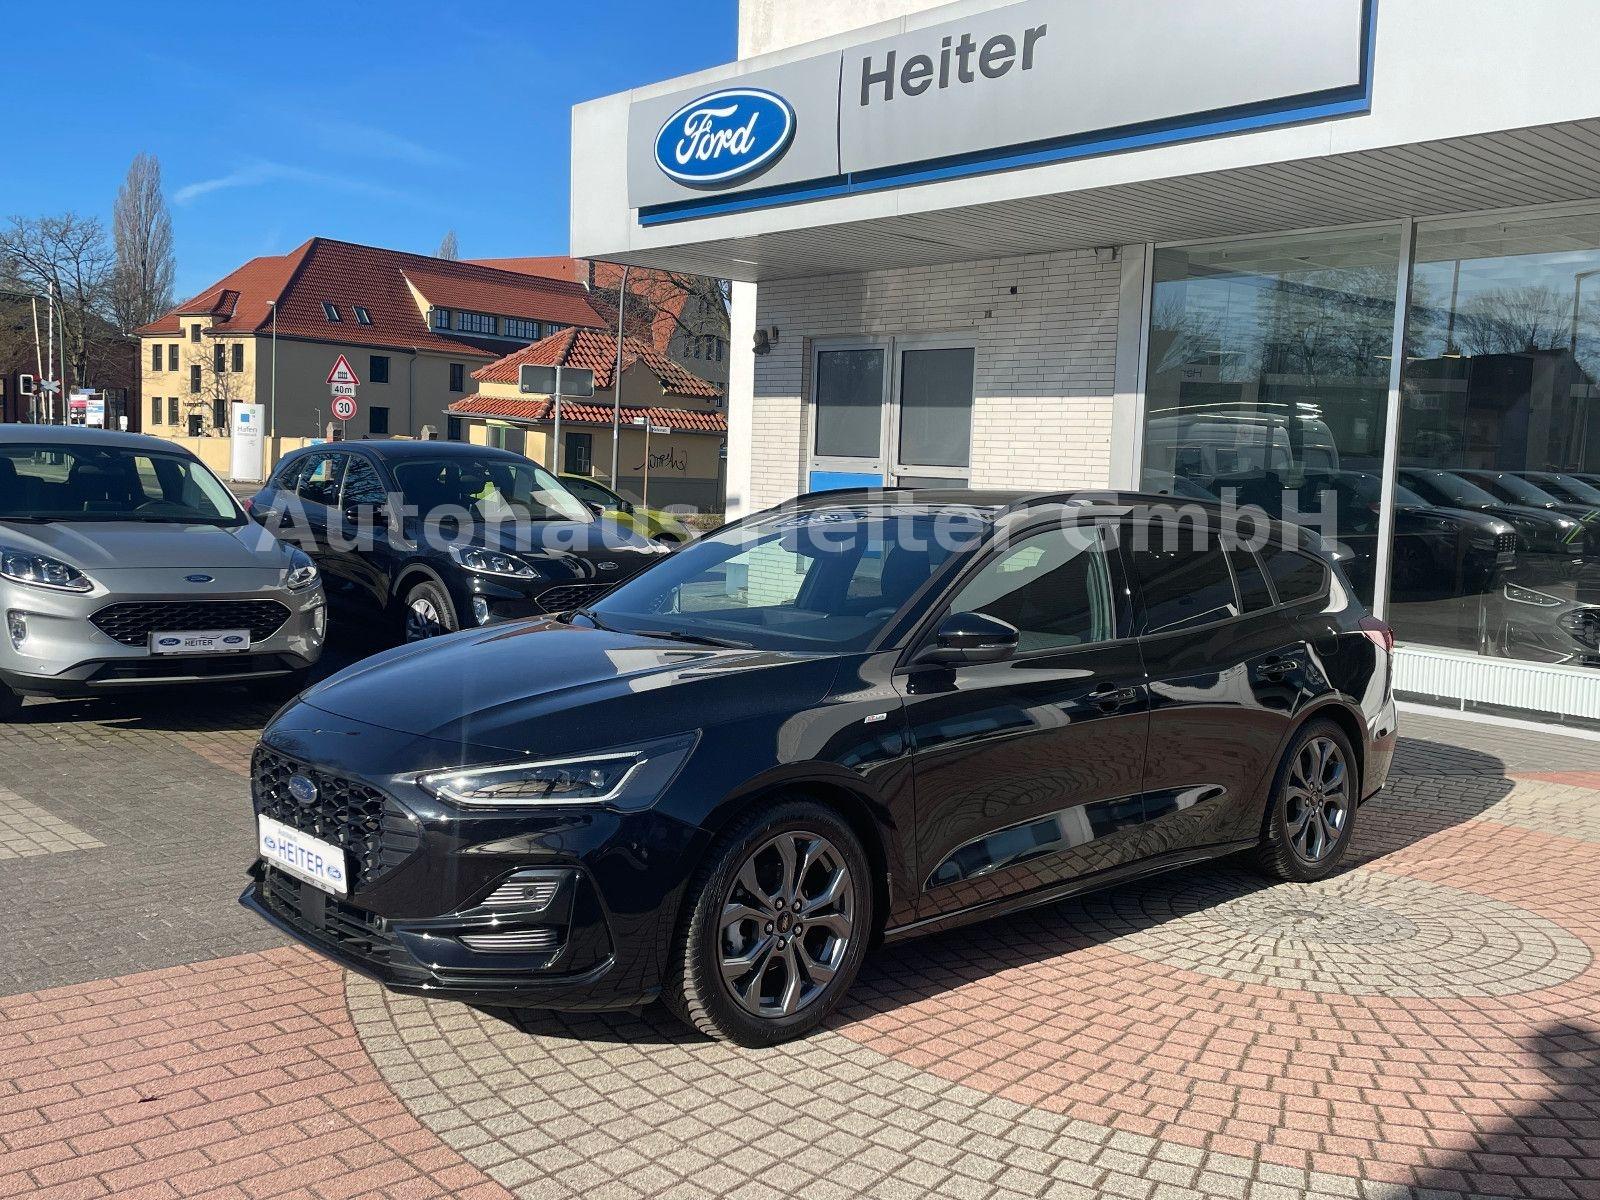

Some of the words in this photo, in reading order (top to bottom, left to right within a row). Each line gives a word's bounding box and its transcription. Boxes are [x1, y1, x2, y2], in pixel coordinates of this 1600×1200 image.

[859, 22, 1048, 107] Heiter
[675, 104, 760, 165] Ford
[338, 402, 350, 414] 30
[237, 425, 258, 433] Hafen
[184, 639, 213, 647] HEITER
[278, 837, 324, 878] HEITER
